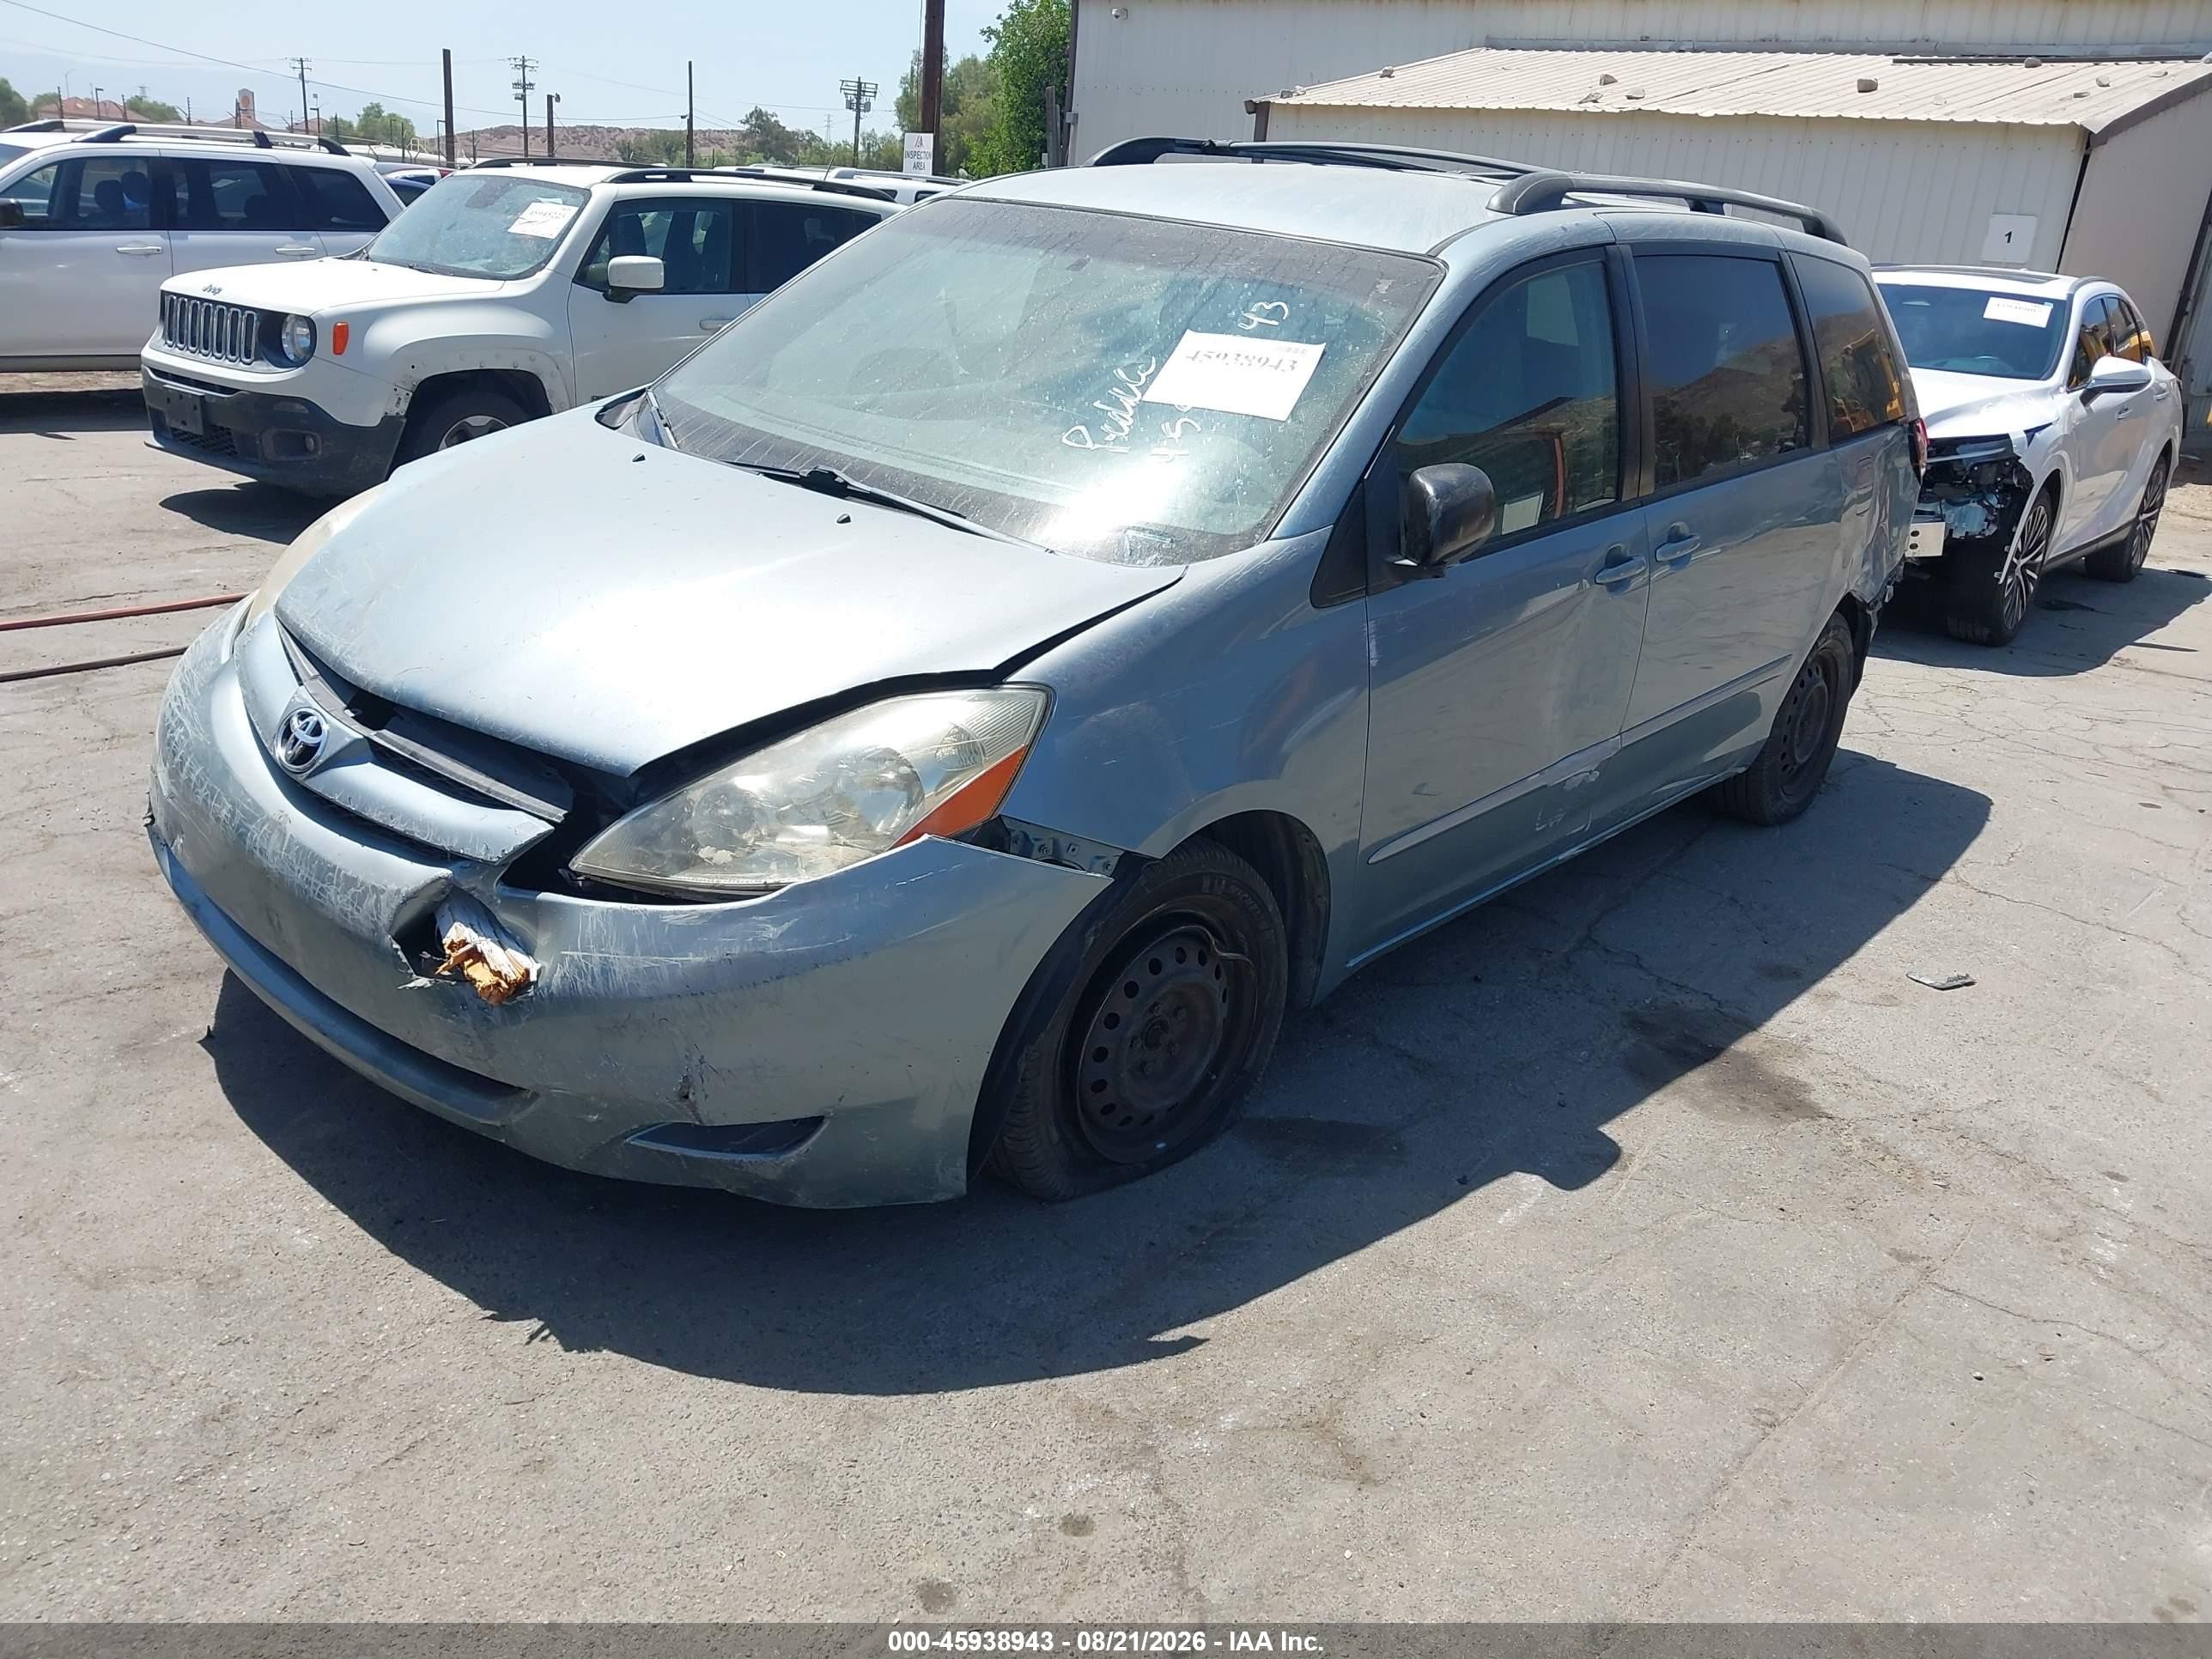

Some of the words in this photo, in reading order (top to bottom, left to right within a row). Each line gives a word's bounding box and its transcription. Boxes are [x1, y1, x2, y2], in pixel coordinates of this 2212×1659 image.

[905, 150, 932, 160] INSPECTION
[912, 161, 926, 171] AREA
[2004, 231, 2013, 244] 1
[1237, 301, 1290, 331] 43
